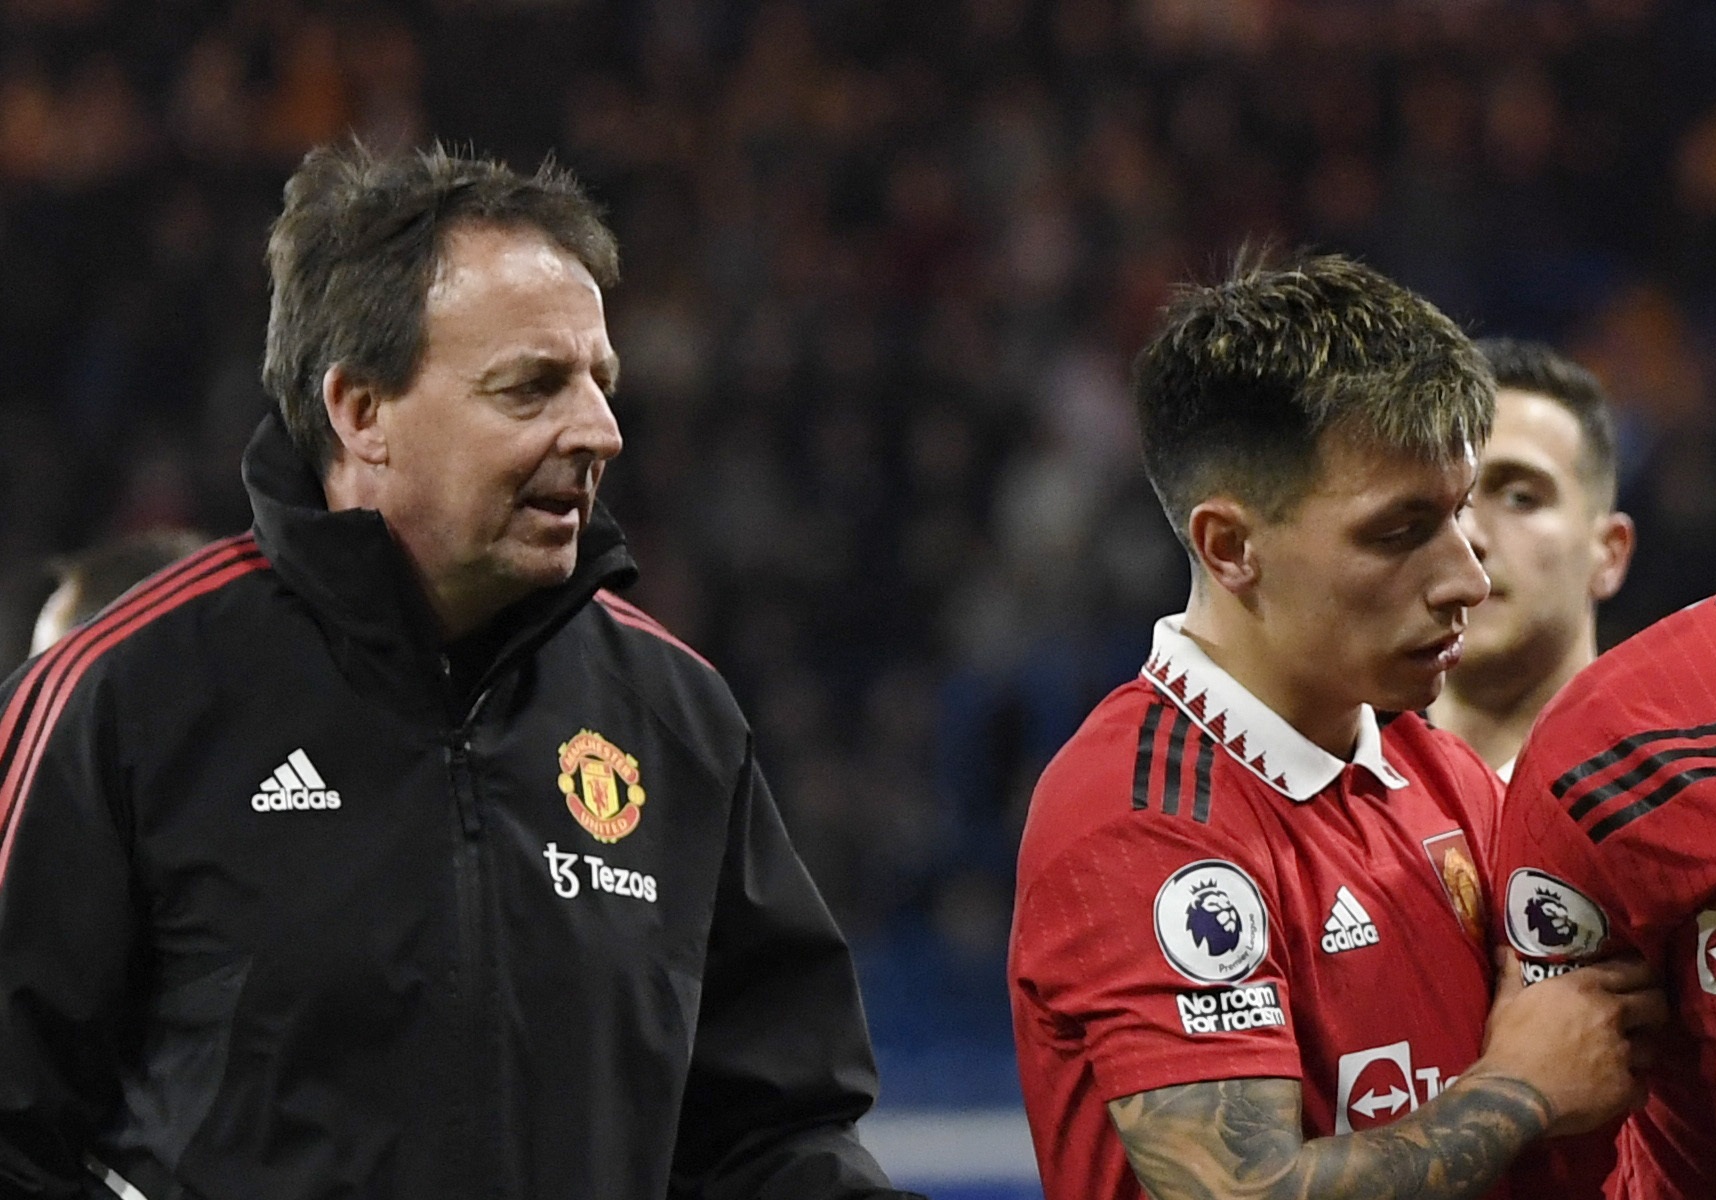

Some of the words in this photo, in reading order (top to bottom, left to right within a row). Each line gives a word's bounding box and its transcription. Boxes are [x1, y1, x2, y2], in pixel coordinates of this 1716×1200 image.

[564, 736, 633, 778] MANCHESTER
[251, 786, 342, 813] adidas
[579, 811, 629, 835] UNITED
[583, 855, 657, 903] Tezos
[1218, 950, 1250, 974] Premier
[1176, 992, 1217, 1016] No
[1220, 986, 1276, 1011] room
[1182, 1013, 1219, 1034] for
[1222, 1006, 1286, 1032] racism
